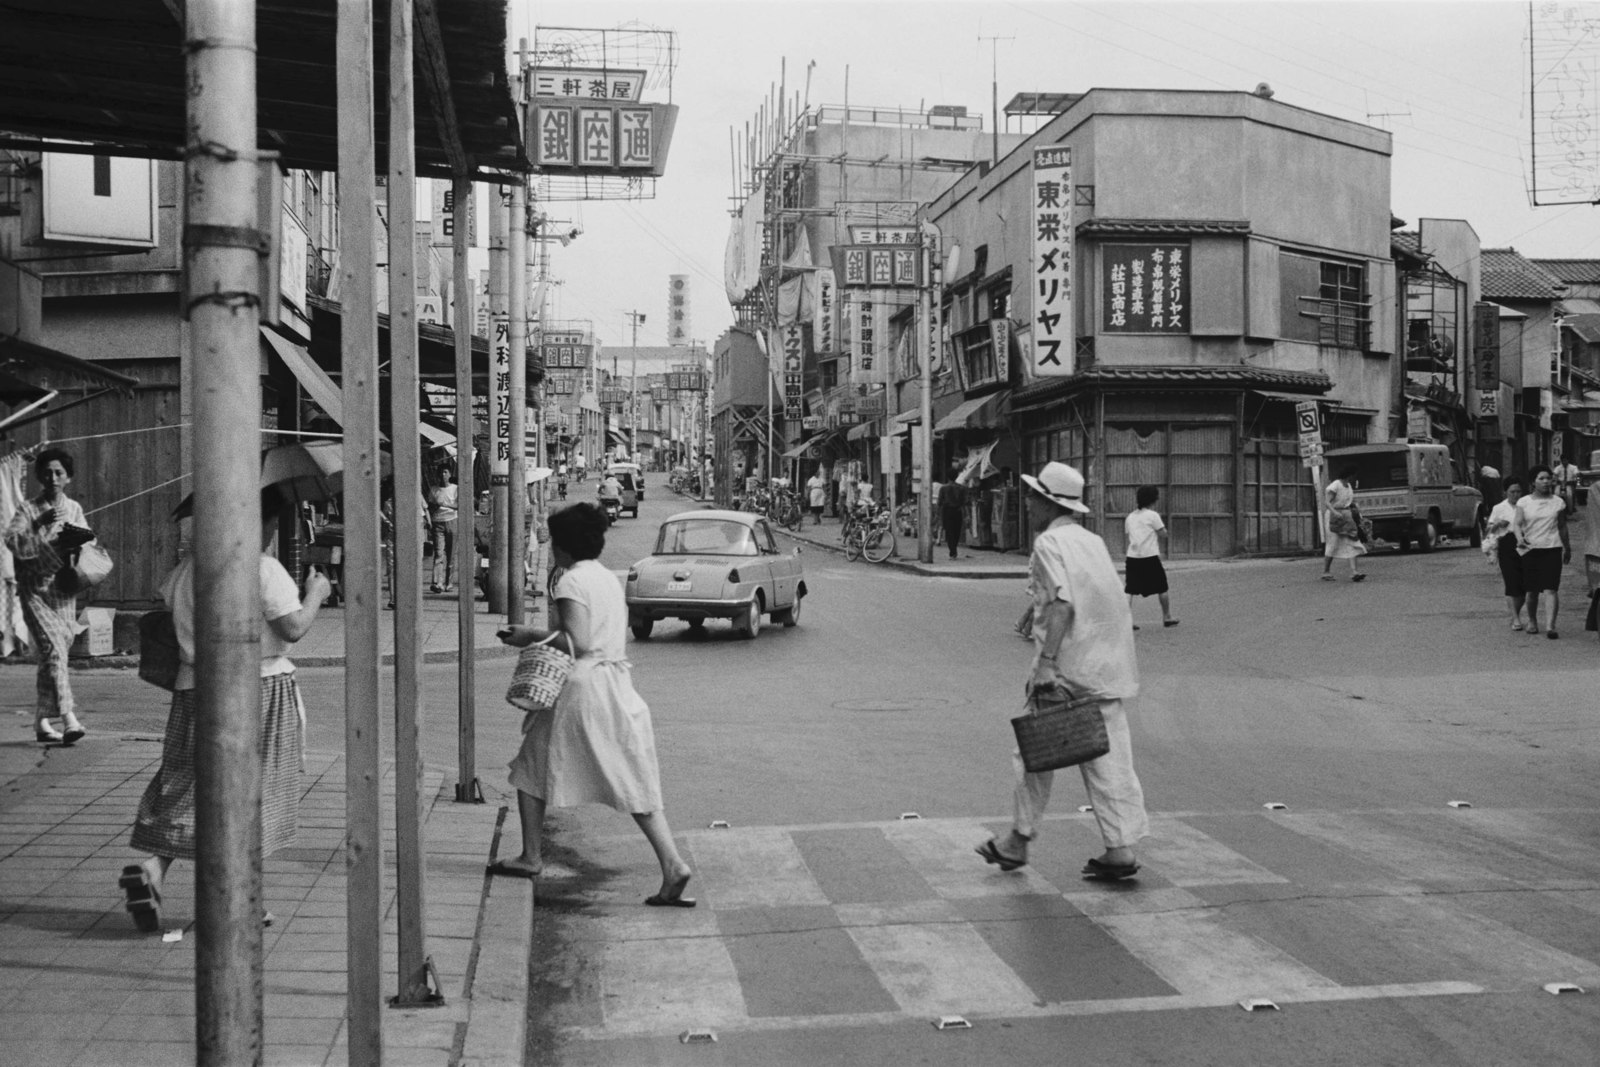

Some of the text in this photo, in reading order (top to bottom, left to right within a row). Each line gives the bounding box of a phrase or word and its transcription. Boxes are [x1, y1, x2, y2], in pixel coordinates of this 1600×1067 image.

[536, 77, 631, 98] 三軒茶屋
[543, 110, 650, 162] 銀座通
[860, 231, 916, 244] 三軒茶屋
[848, 251, 914, 282] 銀座通
[1037, 180, 1061, 367] 東栄メリヤス
[1131, 258, 1145, 315] 製造直売
[1169, 247, 1183, 328] 東栄メリヤス
[785, 337, 801, 371] クスリ
